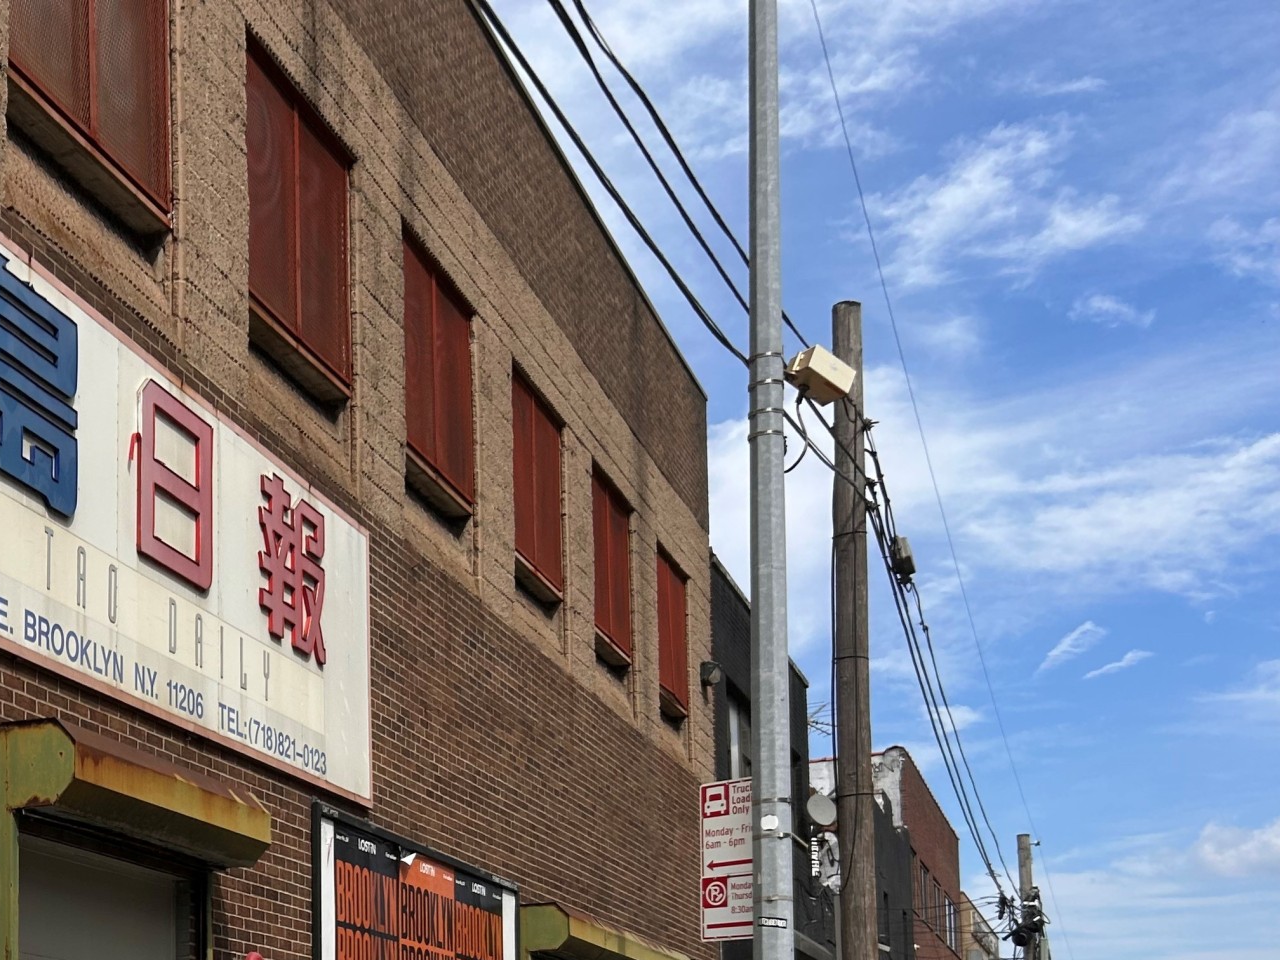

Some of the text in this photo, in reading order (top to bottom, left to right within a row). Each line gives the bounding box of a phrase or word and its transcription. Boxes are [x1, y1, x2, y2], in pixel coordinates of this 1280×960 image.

[45, 526, 118, 624] TAO
[169, 597, 271, 702] DAILY
[24, 608, 124, 684] BROOKLYN
[135, 662, 159, 700] N.Y.
[167, 680, 204, 719] 11206
[705, 827, 734, 838] Monday
[705, 838, 746, 849] 6am 6pm
[732, 805, 750, 815] Only
[336, 859, 399, 937] BROOKLYN
[400, 882, 456, 952] BROOKLYN
